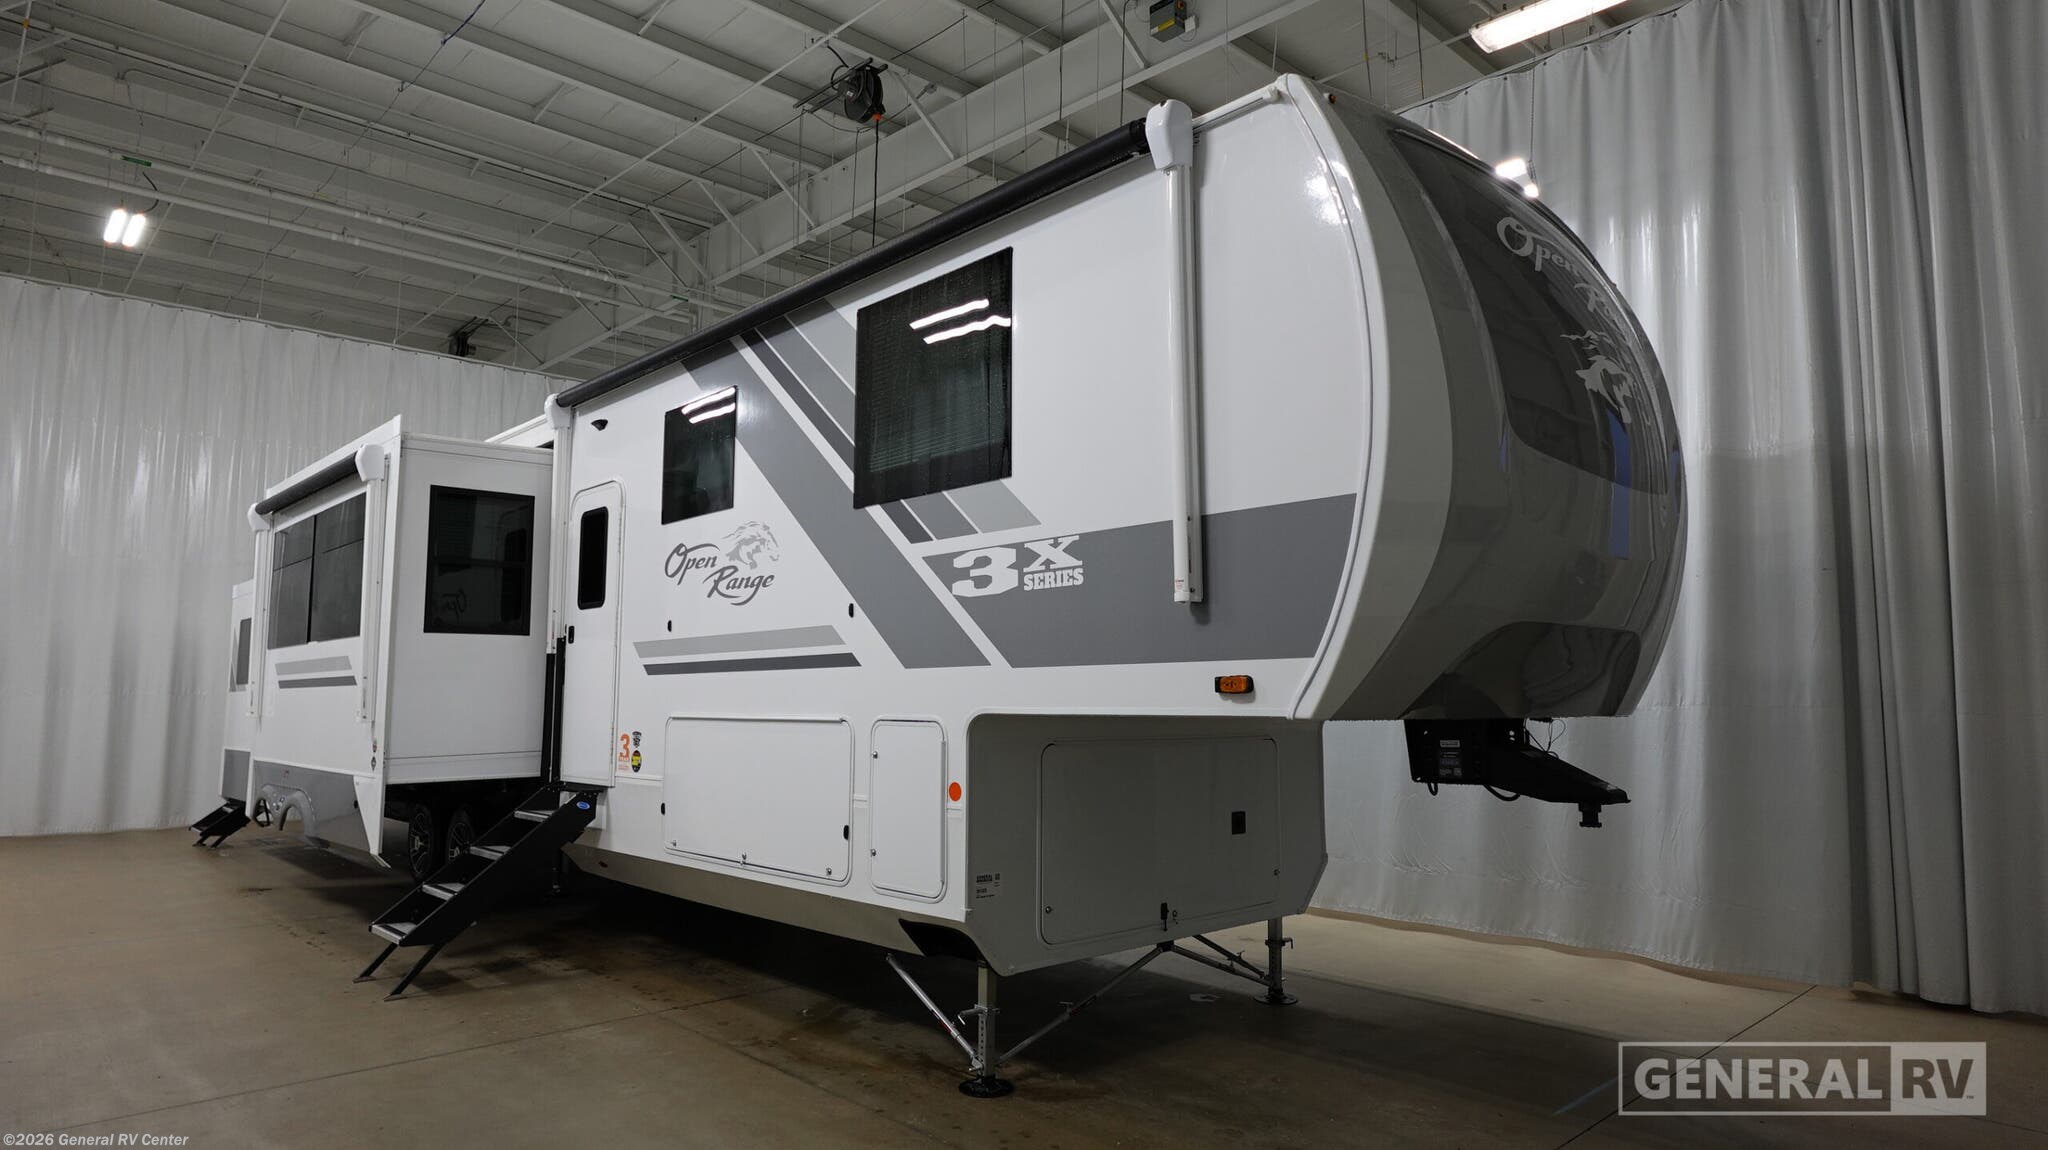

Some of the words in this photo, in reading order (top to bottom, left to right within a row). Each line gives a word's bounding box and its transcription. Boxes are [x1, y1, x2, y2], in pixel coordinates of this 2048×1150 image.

[664, 543, 720, 586] Open
[1023, 568, 1084, 591] SERIES
[702, 565, 775, 606] Range
